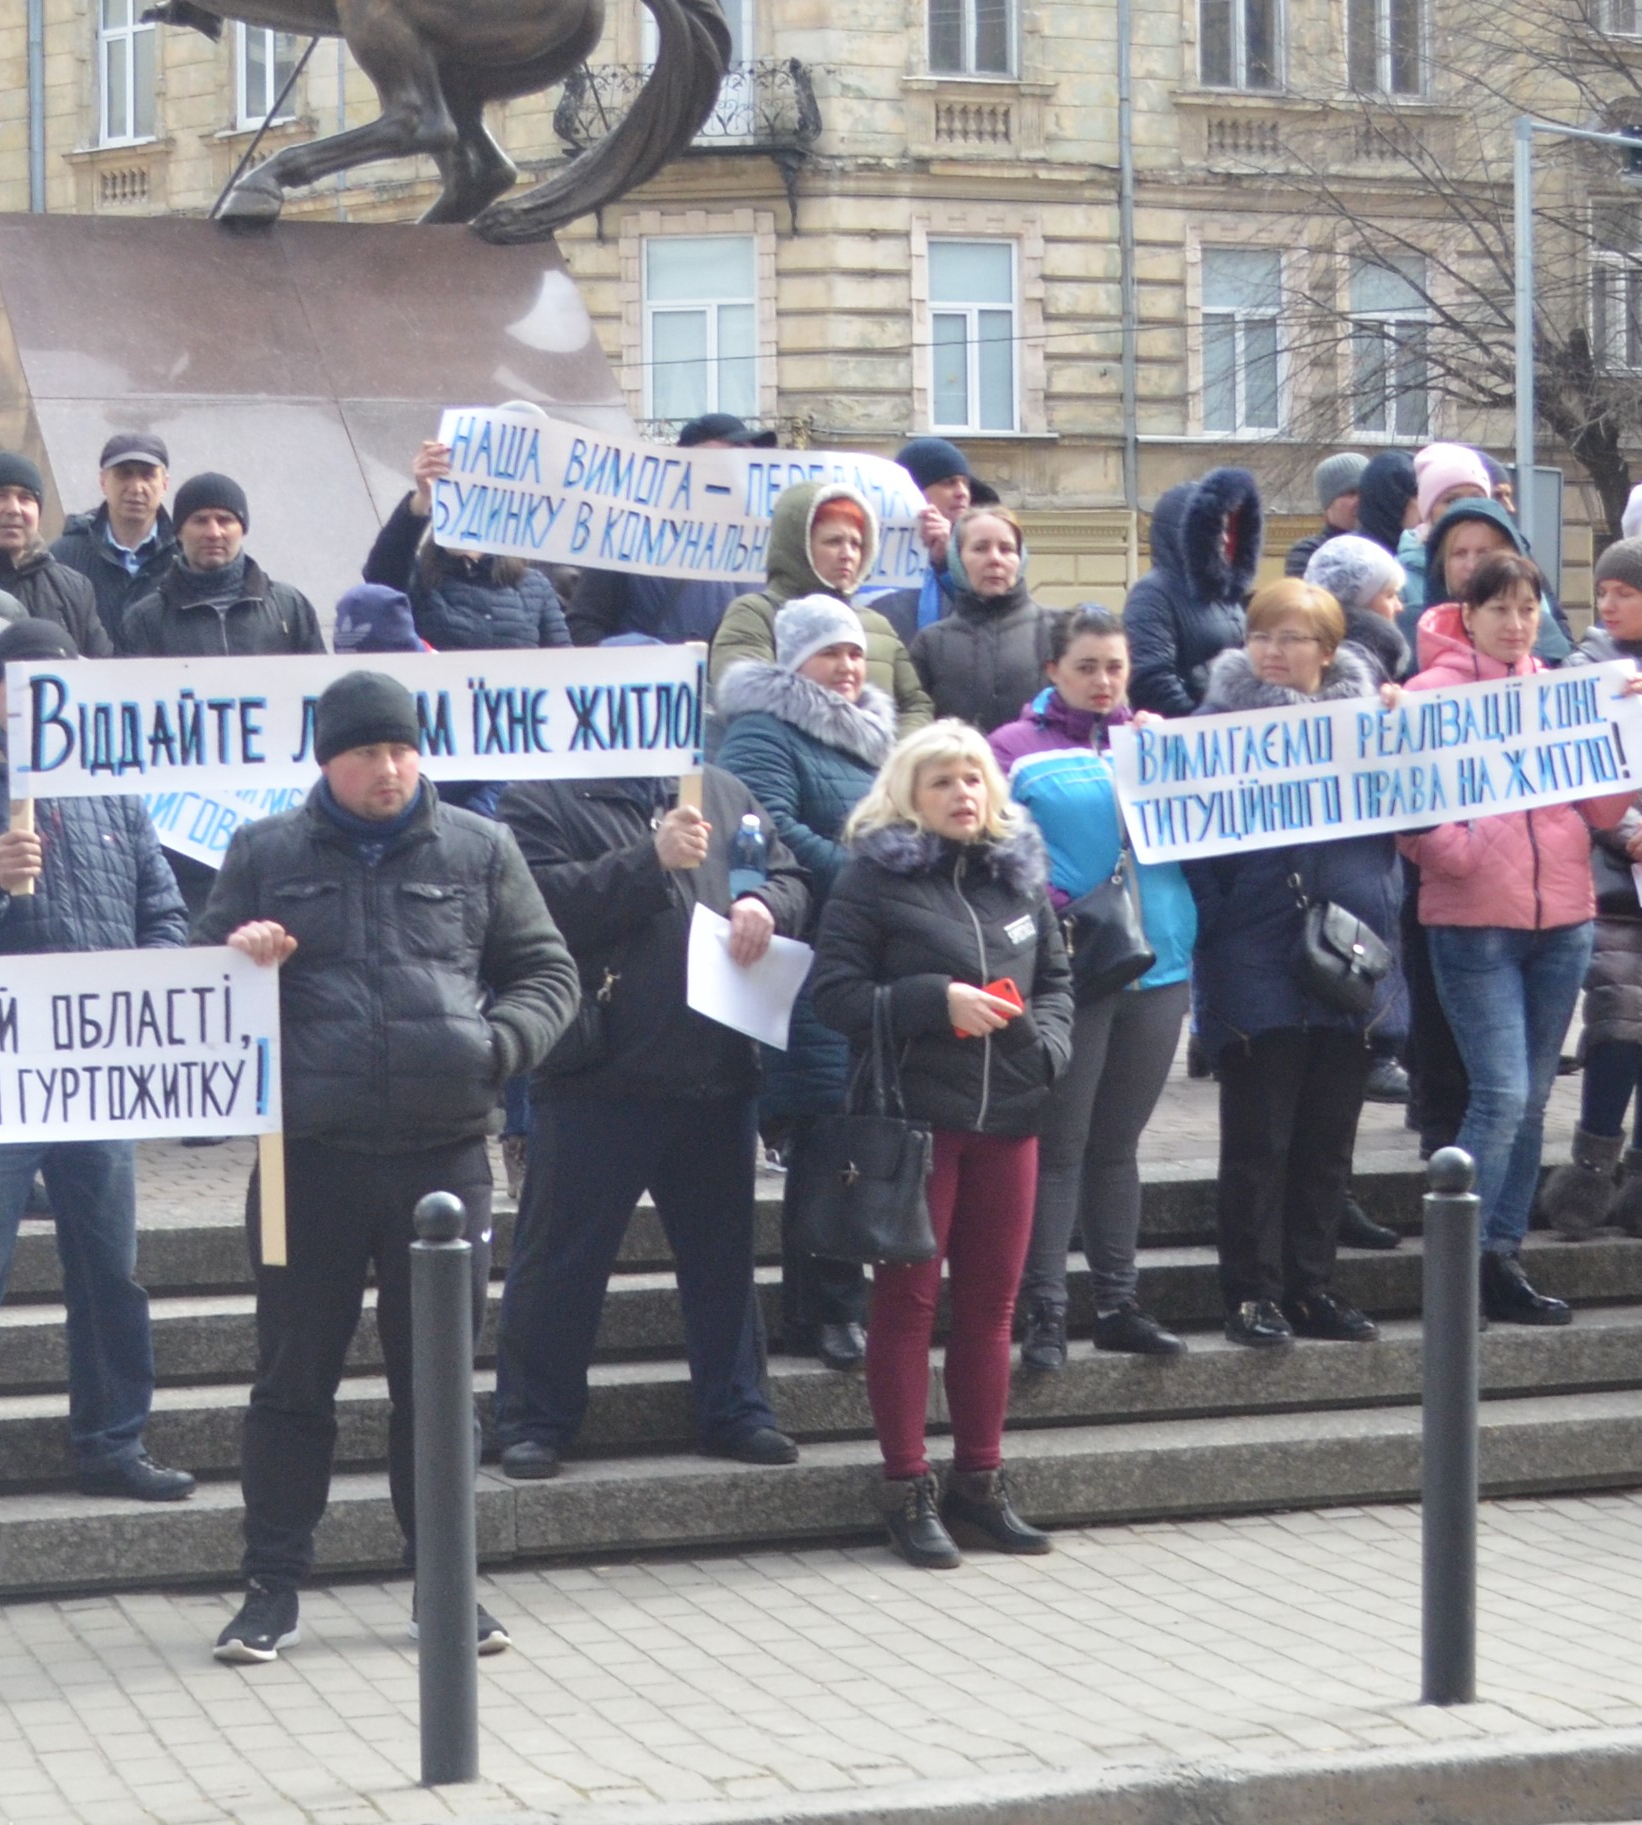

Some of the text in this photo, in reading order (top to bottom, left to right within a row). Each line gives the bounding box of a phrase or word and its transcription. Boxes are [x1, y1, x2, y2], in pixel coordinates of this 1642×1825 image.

[448, 415, 541, 485] НАША
[563, 438, 692, 511] ВИМОГА
[433, 478, 772, 574] БУДИНКУ В КОМУНАЛЬН
[468, 676, 553, 755] ЇХНЄ
[565, 660, 706, 767] ЖИТЛО!
[1137, 714, 1333, 786] ВИМАГАЄМО
[1356, 682, 1523, 759] РЕАЛІЗАЦІЇ
[1131, 721, 1631, 848] ТИТУЦІЙНОГО ПРАВА НА ЖИТЛО!
